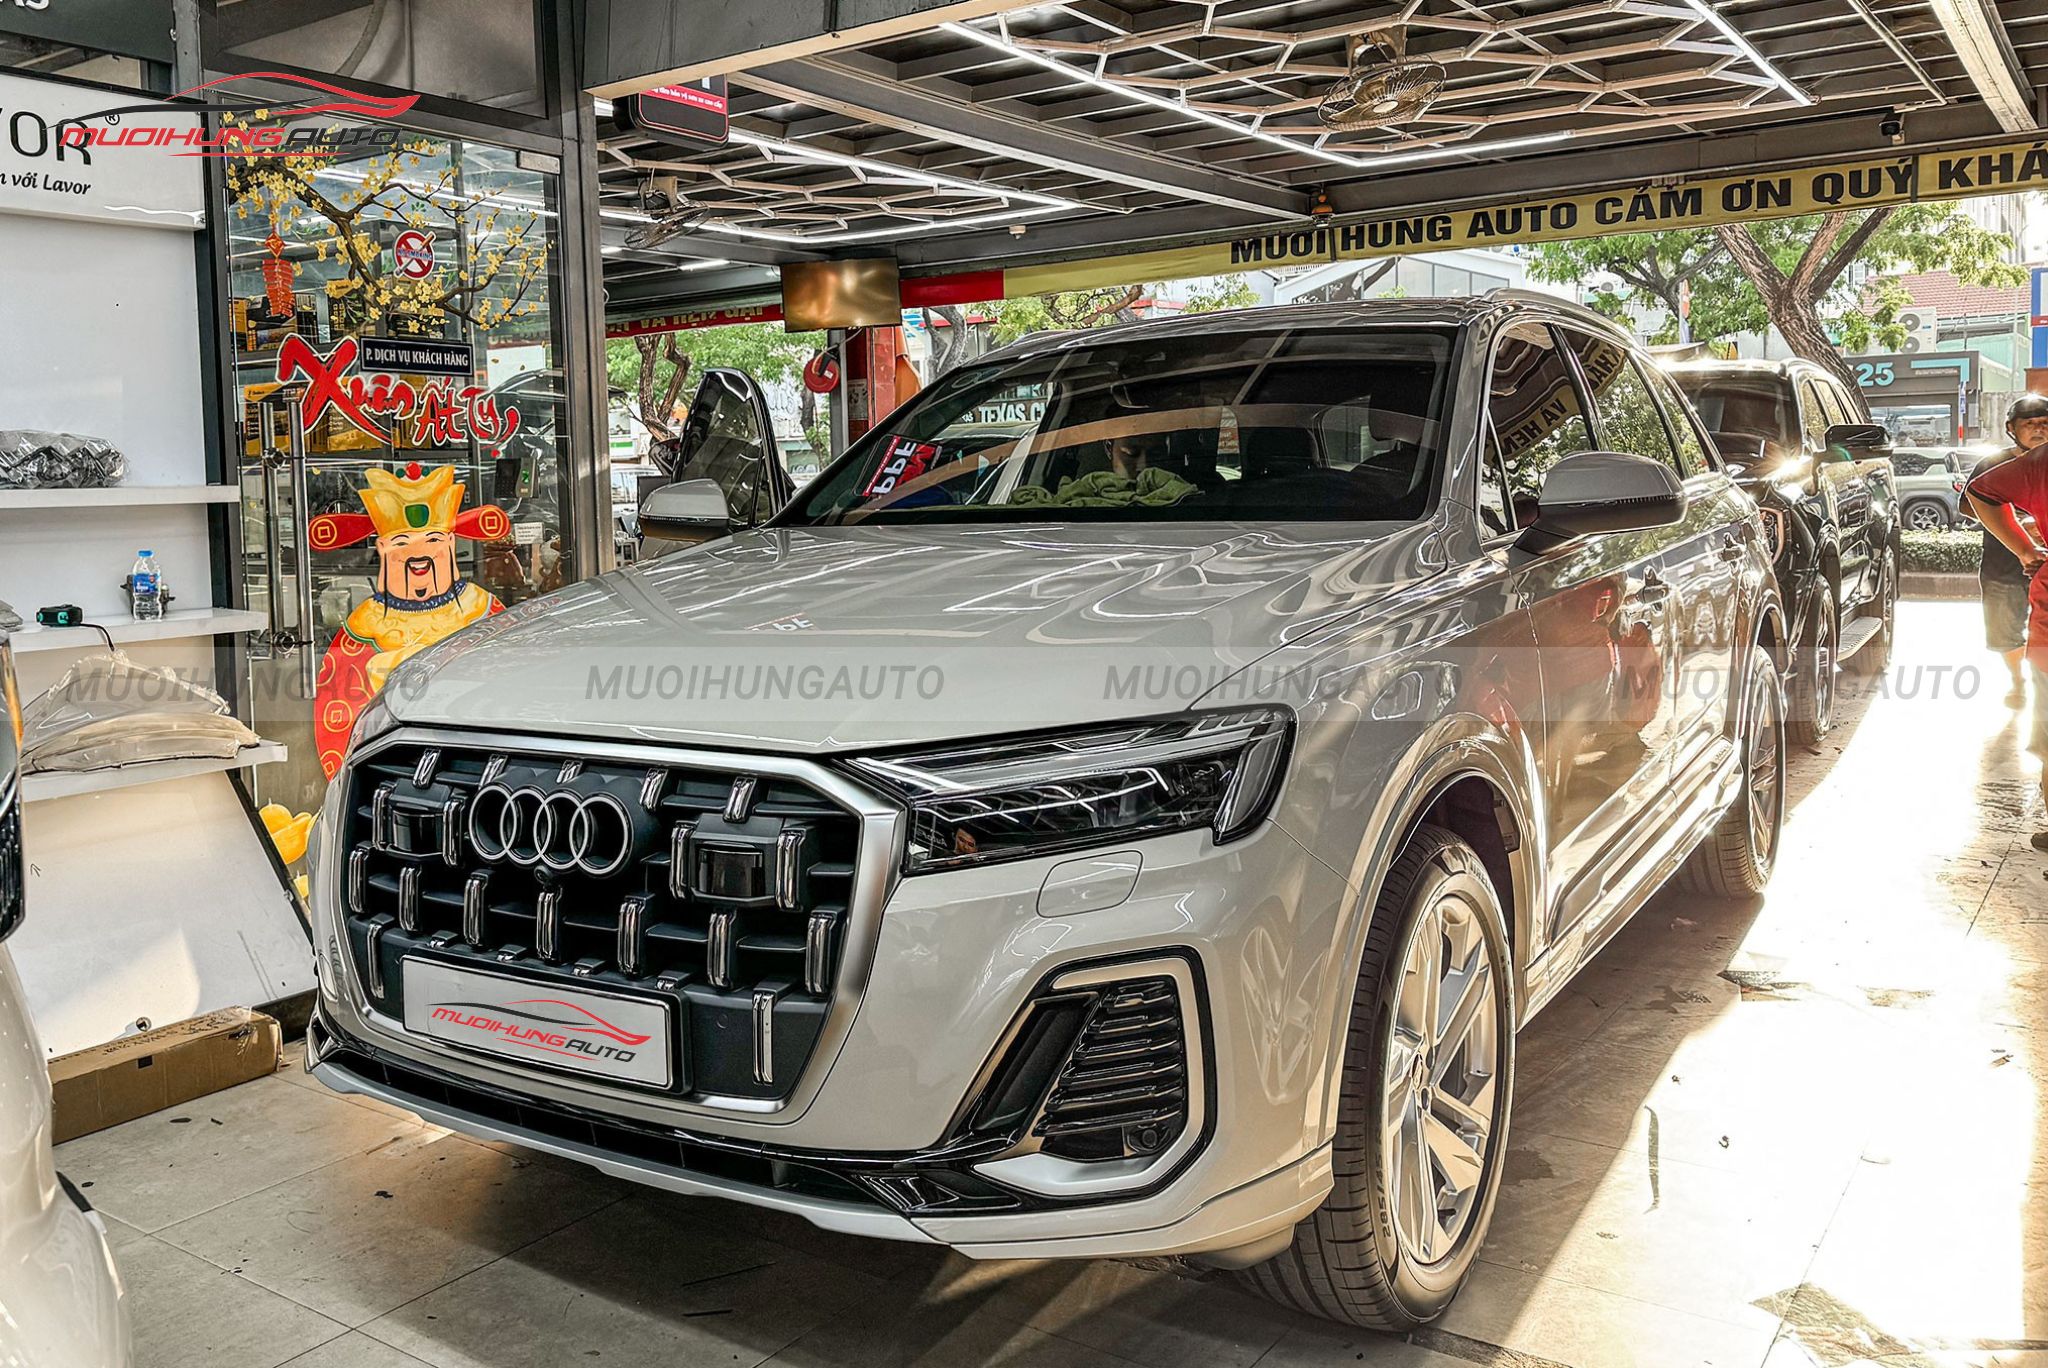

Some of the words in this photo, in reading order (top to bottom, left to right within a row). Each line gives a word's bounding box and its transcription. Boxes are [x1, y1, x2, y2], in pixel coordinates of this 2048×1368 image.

[12, 172, 38, 189] với
[43, 174, 92, 195] Lavor
[1466, 201, 1578, 239] AUTO
[1721, 178, 1792, 212] ƠN
[1811, 156, 1913, 205] QUÝ
[365, 347, 373, 360] P.
[374, 348, 396, 364] DỊCH
[398, 349, 410, 365] VỤ
[412, 348, 443, 365] KHÁCH
[444, 350, 469, 366] HÀNG
[1855, 362, 1895, 387] 25
[978, 402, 1026, 423] TEXAS
[431, 1007, 636, 1063] MUOIHUNGAUTO
